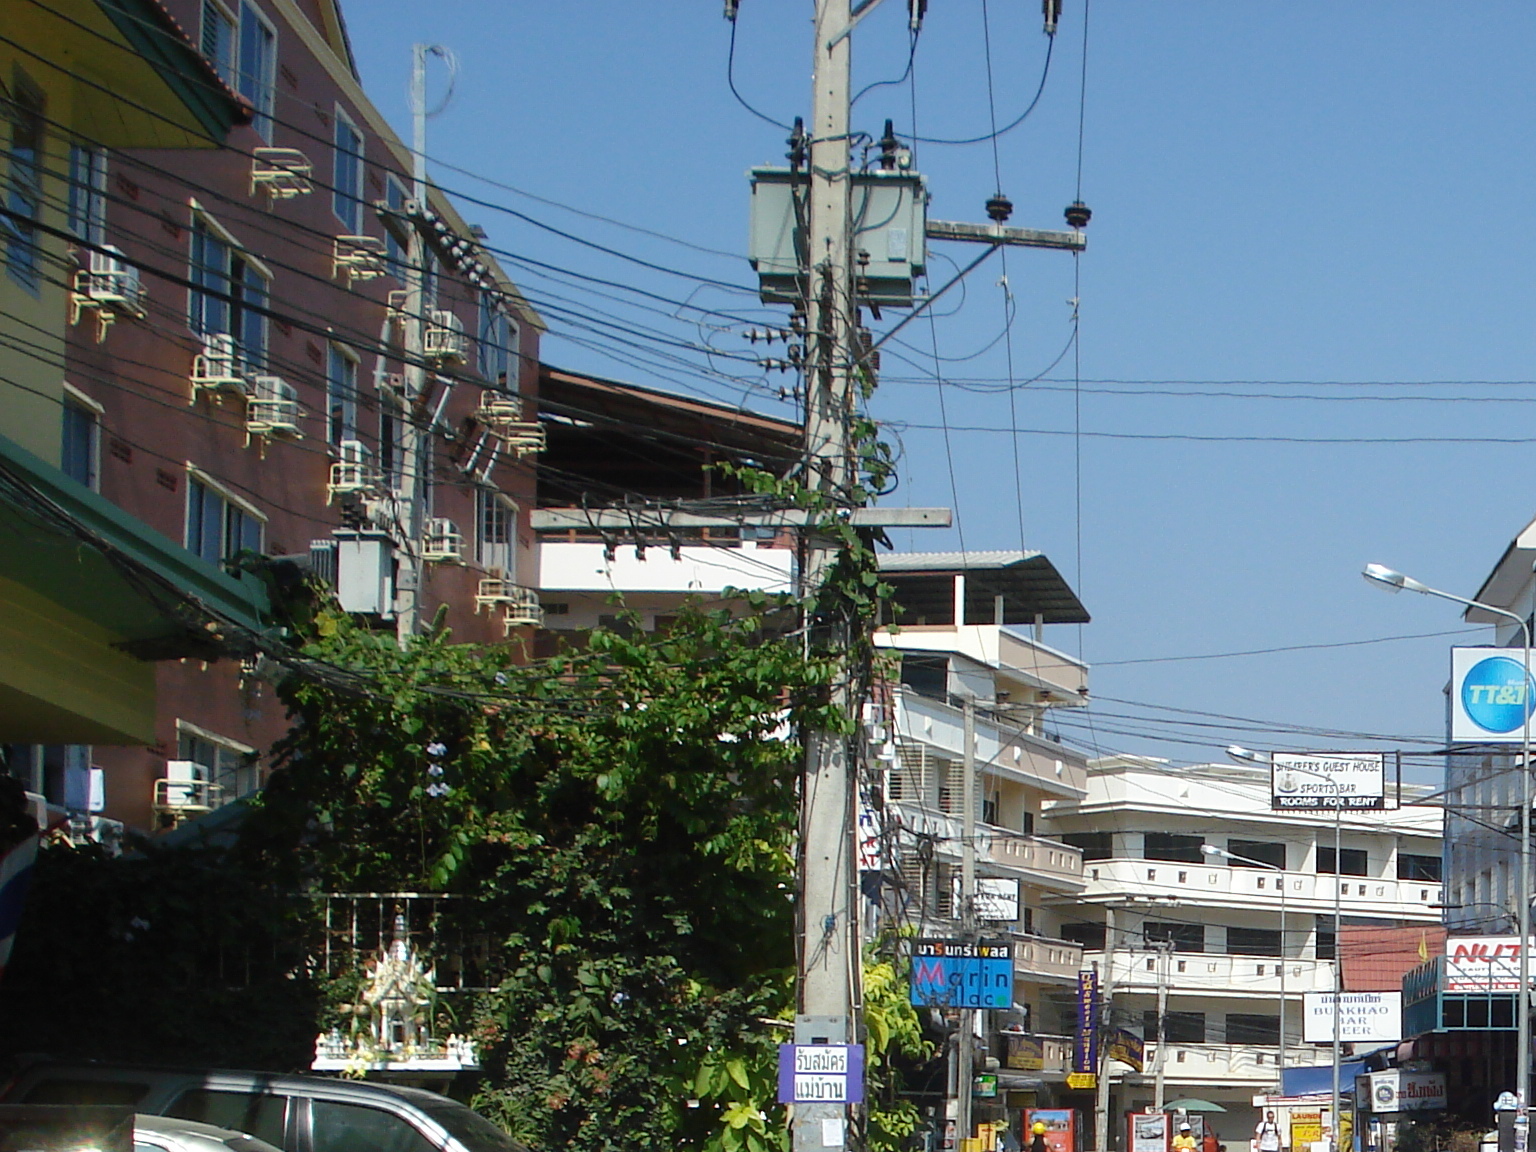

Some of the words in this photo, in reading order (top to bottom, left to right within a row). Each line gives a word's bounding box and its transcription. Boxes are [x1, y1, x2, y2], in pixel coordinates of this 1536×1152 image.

[1323, 762, 1351, 772] GUEST
[1353, 762, 1380, 773] HOUSE
[1300, 783, 1335, 795] SPORTS
[1340, 784, 1357, 794] BAR
[1280, 797, 1318, 806] ROOMS
[1323, 797, 1345, 806] FOR
[1348, 797, 1378, 806] RENT
[1453, 943, 1533, 964] NUT
[917, 960, 1008, 987] Marin
[796, 1048, 845, 1071] รับสมัคร
[796, 1077, 843, 1099] แม่บ้าน
